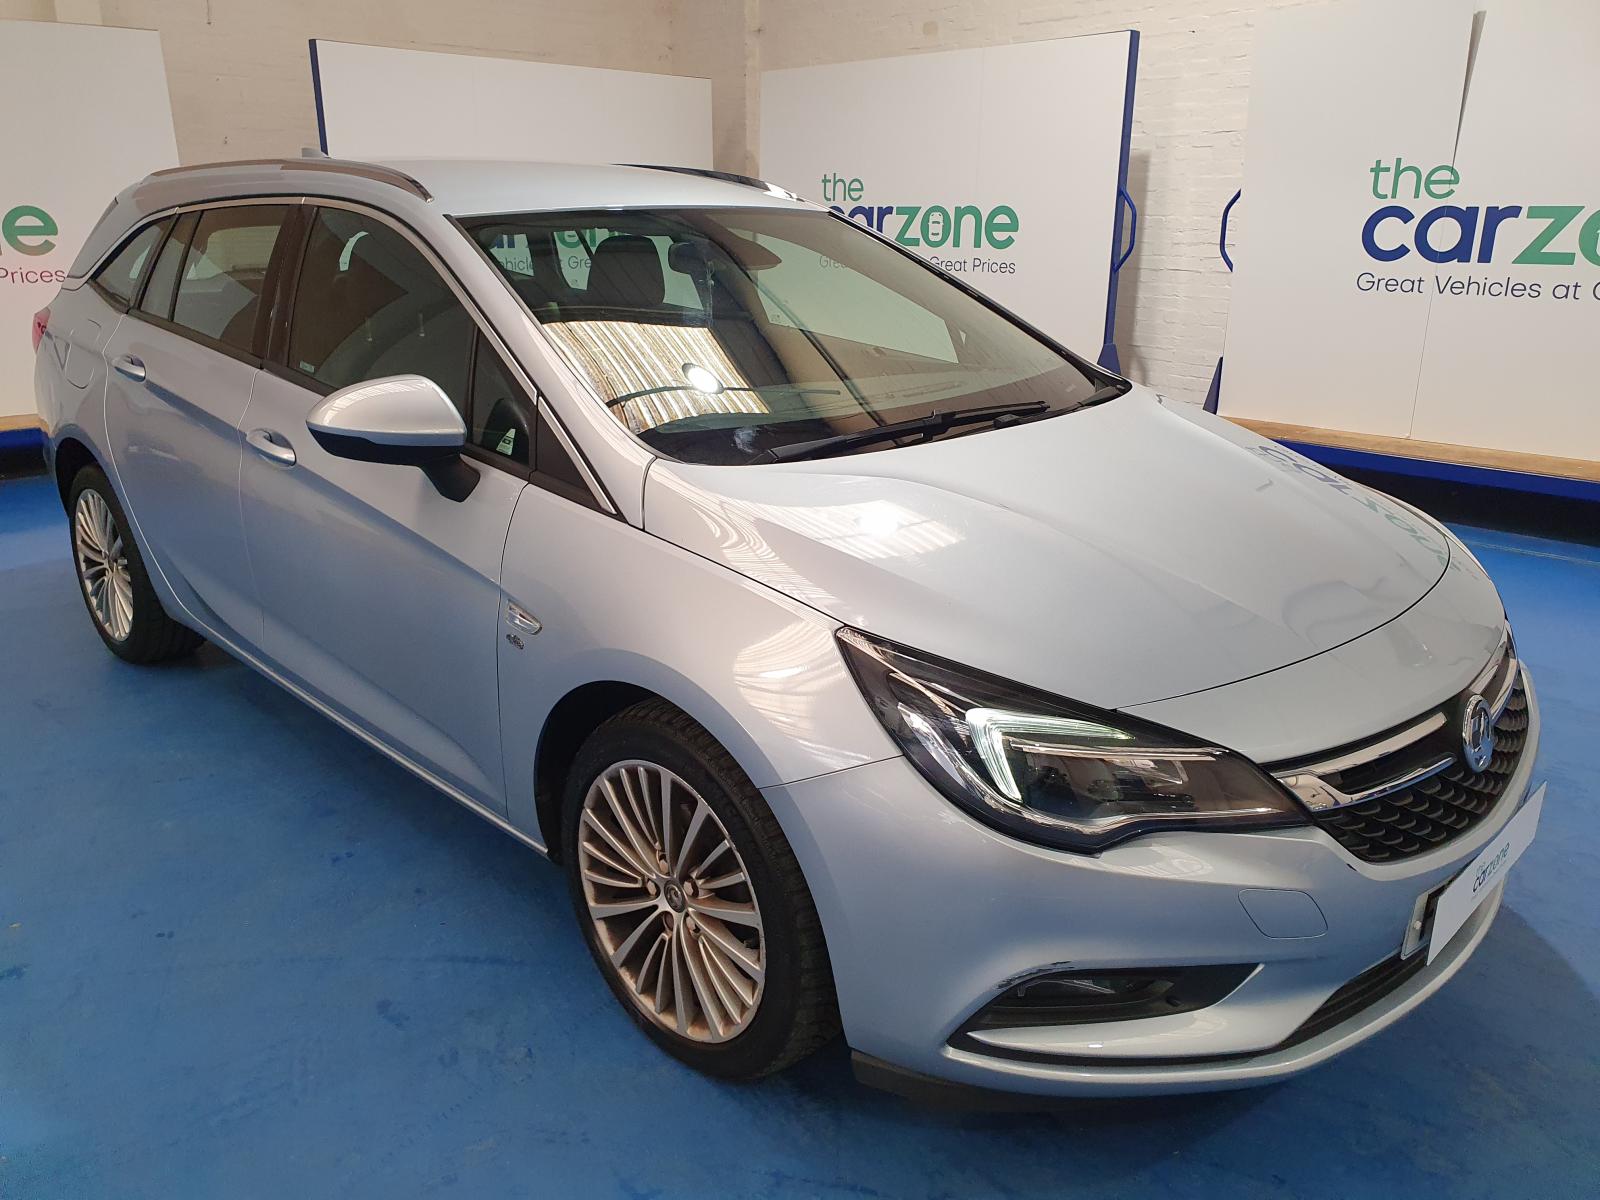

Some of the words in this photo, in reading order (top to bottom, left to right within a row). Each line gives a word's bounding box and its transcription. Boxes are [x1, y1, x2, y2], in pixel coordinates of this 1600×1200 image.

[821, 173, 864, 201] the
[1369, 157, 1460, 200] the
[972, 257, 1016, 274] Prices
[1356, 272, 1425, 294] Great
[1435, 275, 1541, 299] Vehicles
[1552, 282, 1582, 300] at
